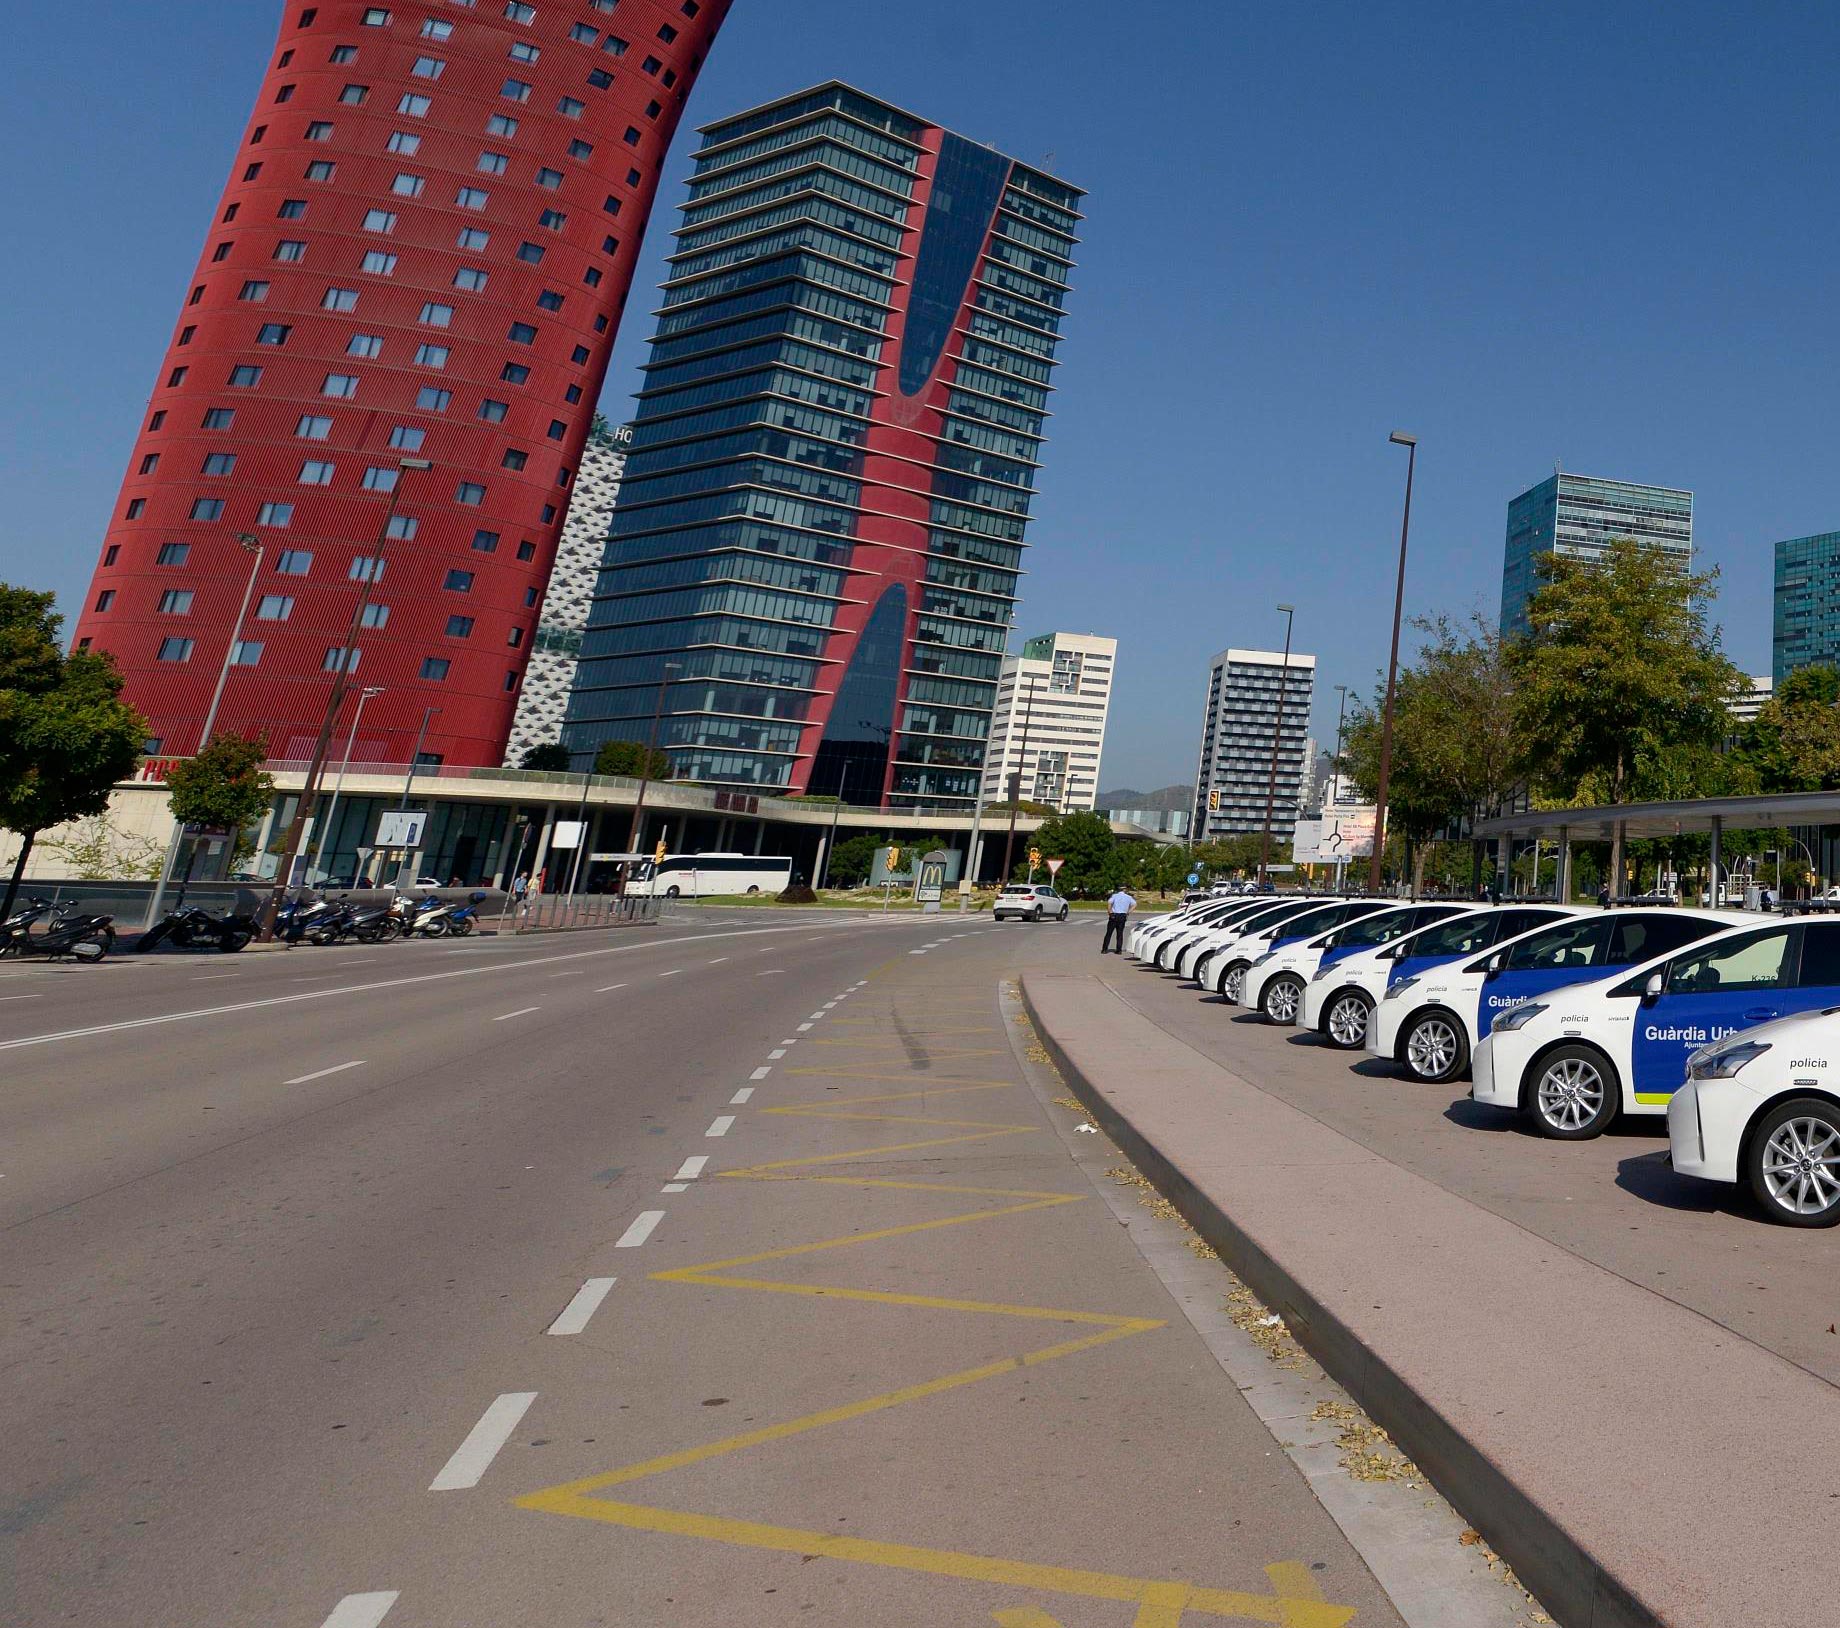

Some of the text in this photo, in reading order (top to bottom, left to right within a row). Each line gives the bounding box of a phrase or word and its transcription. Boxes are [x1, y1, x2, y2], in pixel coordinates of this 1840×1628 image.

[1560, 1014, 1589, 1023] policia
[1645, 1026, 1707, 1041] Guàrdia
[1790, 1058, 1828, 1070] policia
